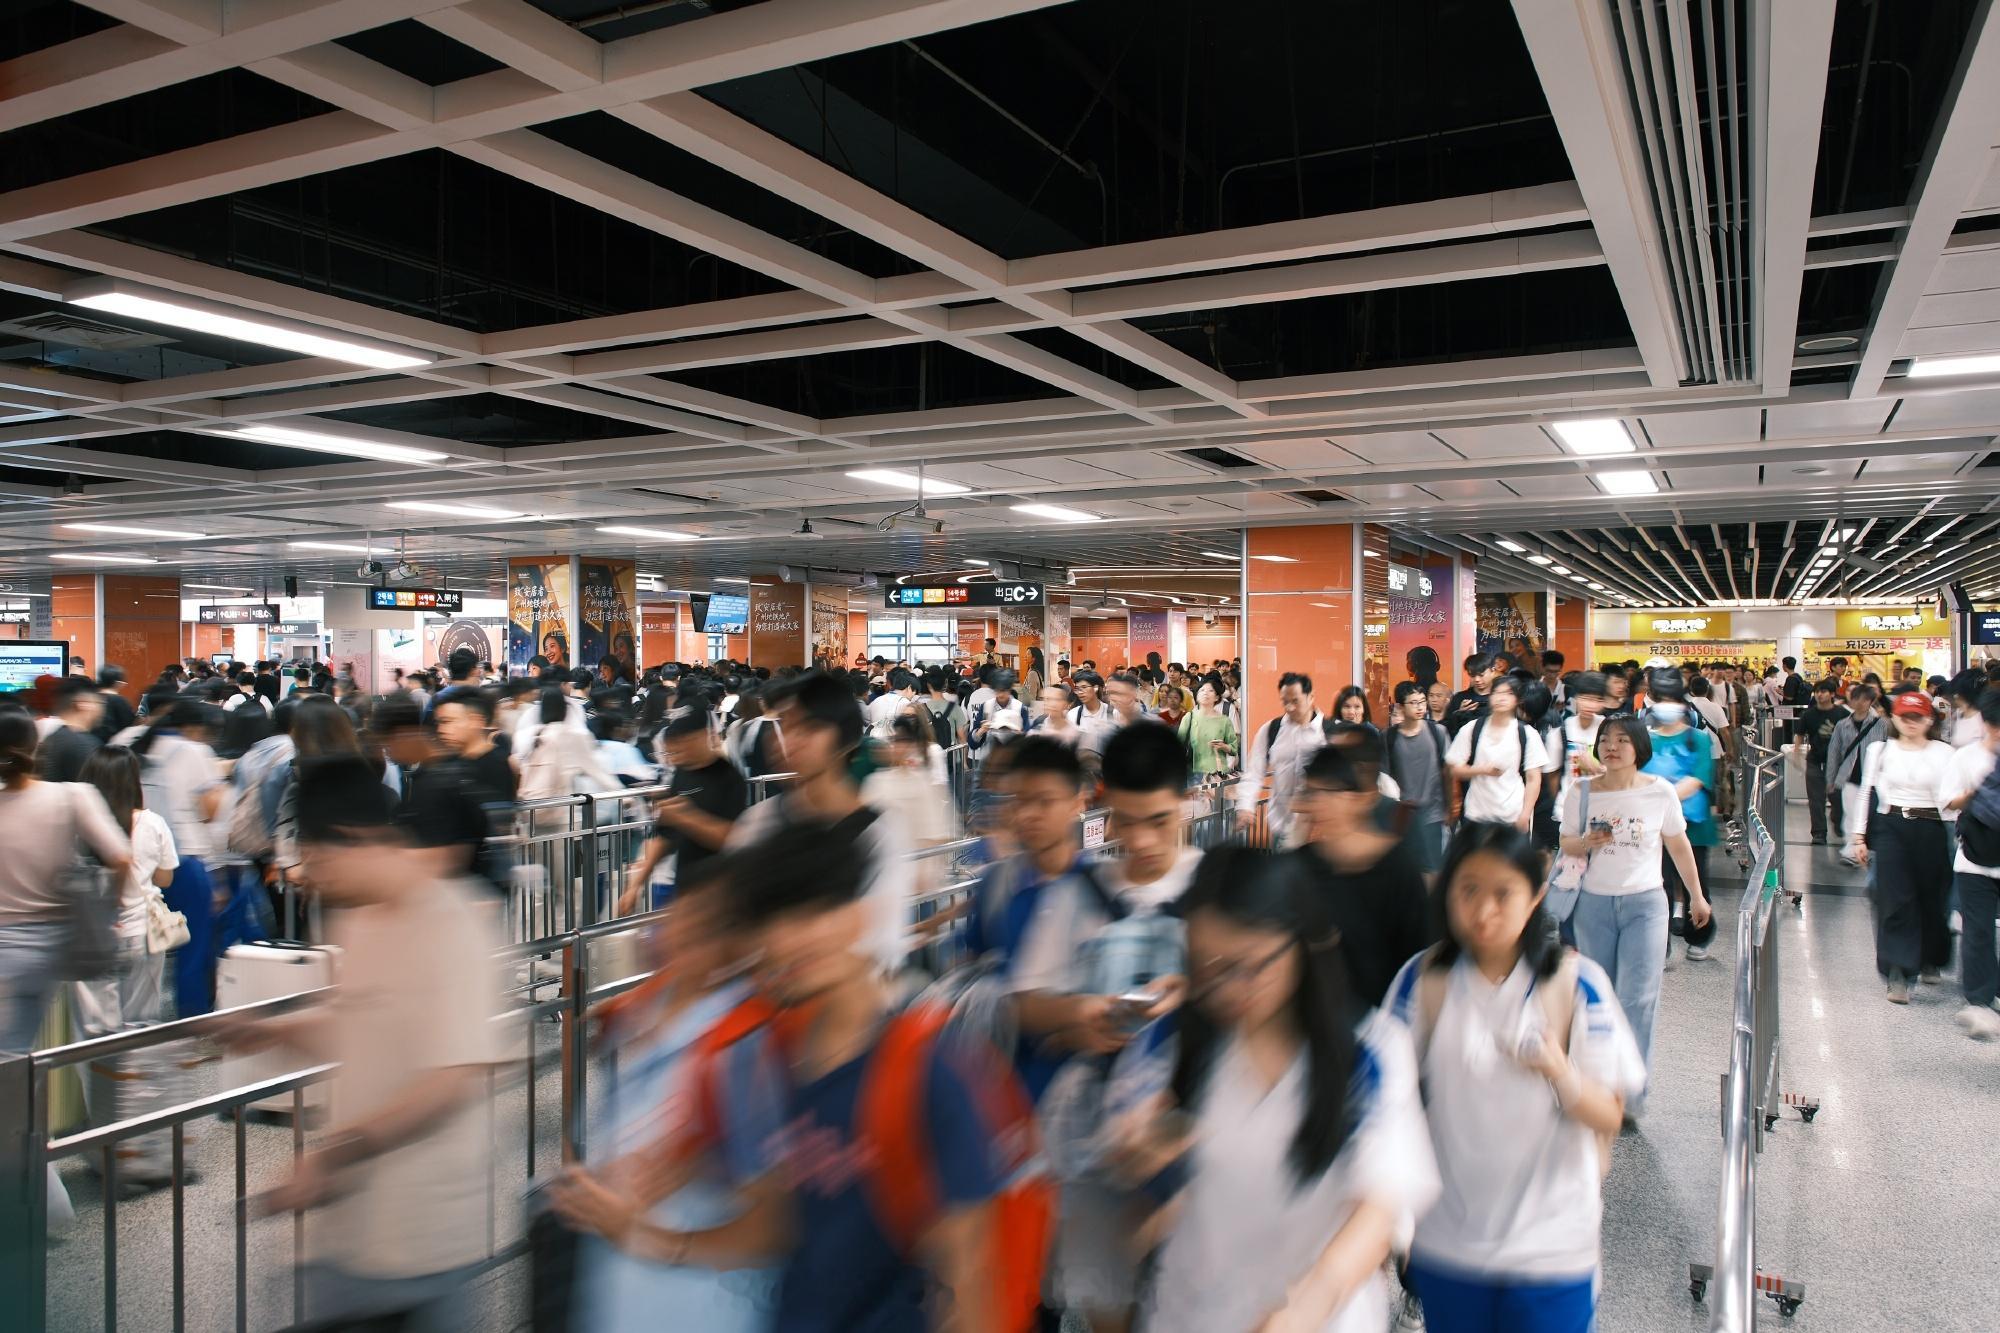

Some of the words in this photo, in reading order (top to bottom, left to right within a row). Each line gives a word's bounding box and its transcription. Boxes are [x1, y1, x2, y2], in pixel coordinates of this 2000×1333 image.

[903, 589, 920, 598] 2号线
[995, 586, 1013, 597] 出口
[1013, 586, 1025, 601] C
[436, 592, 459, 603] 入闸处
[1846, 639, 1886, 650] 充129元
